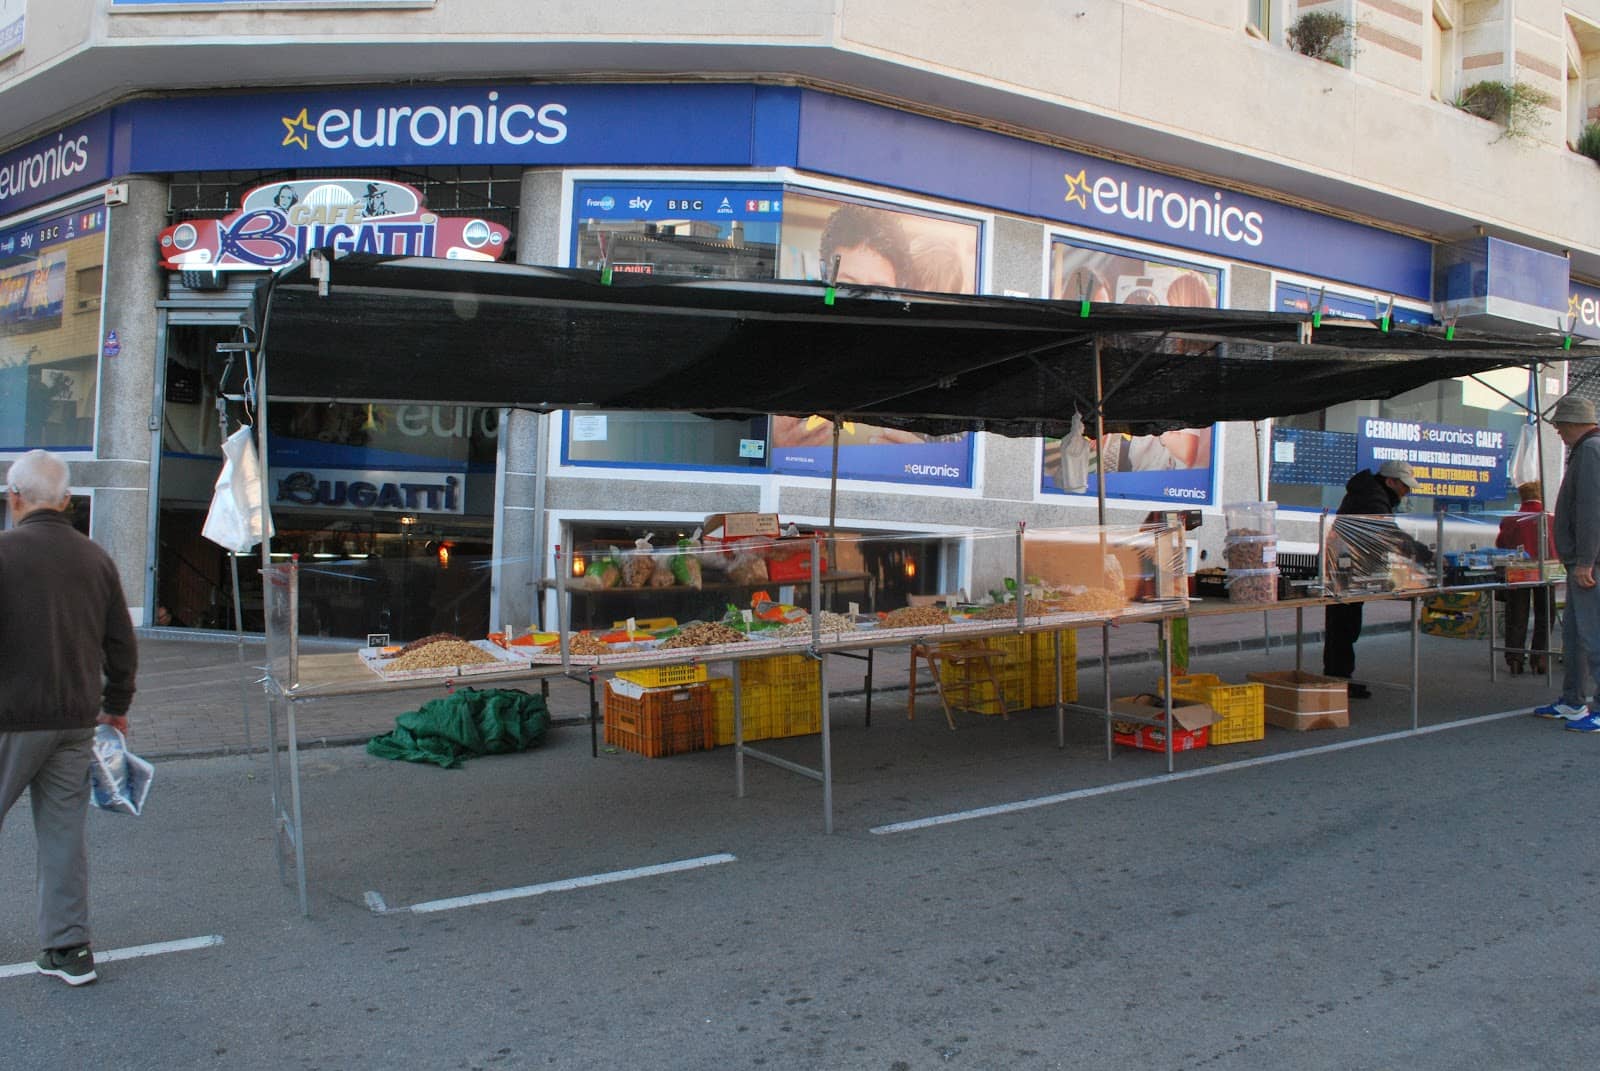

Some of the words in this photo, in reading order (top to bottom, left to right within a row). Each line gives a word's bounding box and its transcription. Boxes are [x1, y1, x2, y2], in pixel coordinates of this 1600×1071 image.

[316, 91, 568, 149] euronics
[0, 133, 89, 200] euronics
[290, 201, 363, 226] CAFÉ
[628, 196, 653, 212] sky
[668, 199, 703, 210] BBC
[1092, 176, 1264, 247] euronics
[1365, 419, 1421, 442] CERRAMOS
[1429, 429, 1474, 445] euronics
[1476, 430, 1503, 449] CALPE
[1408, 449, 1418, 462] EN
[1417, 450, 1450, 465] NUESTRAS
[1450, 453, 1496, 467] INSTALACIONES
[911, 464, 960, 478] euronics
[1168, 487, 1207, 499] euronics
